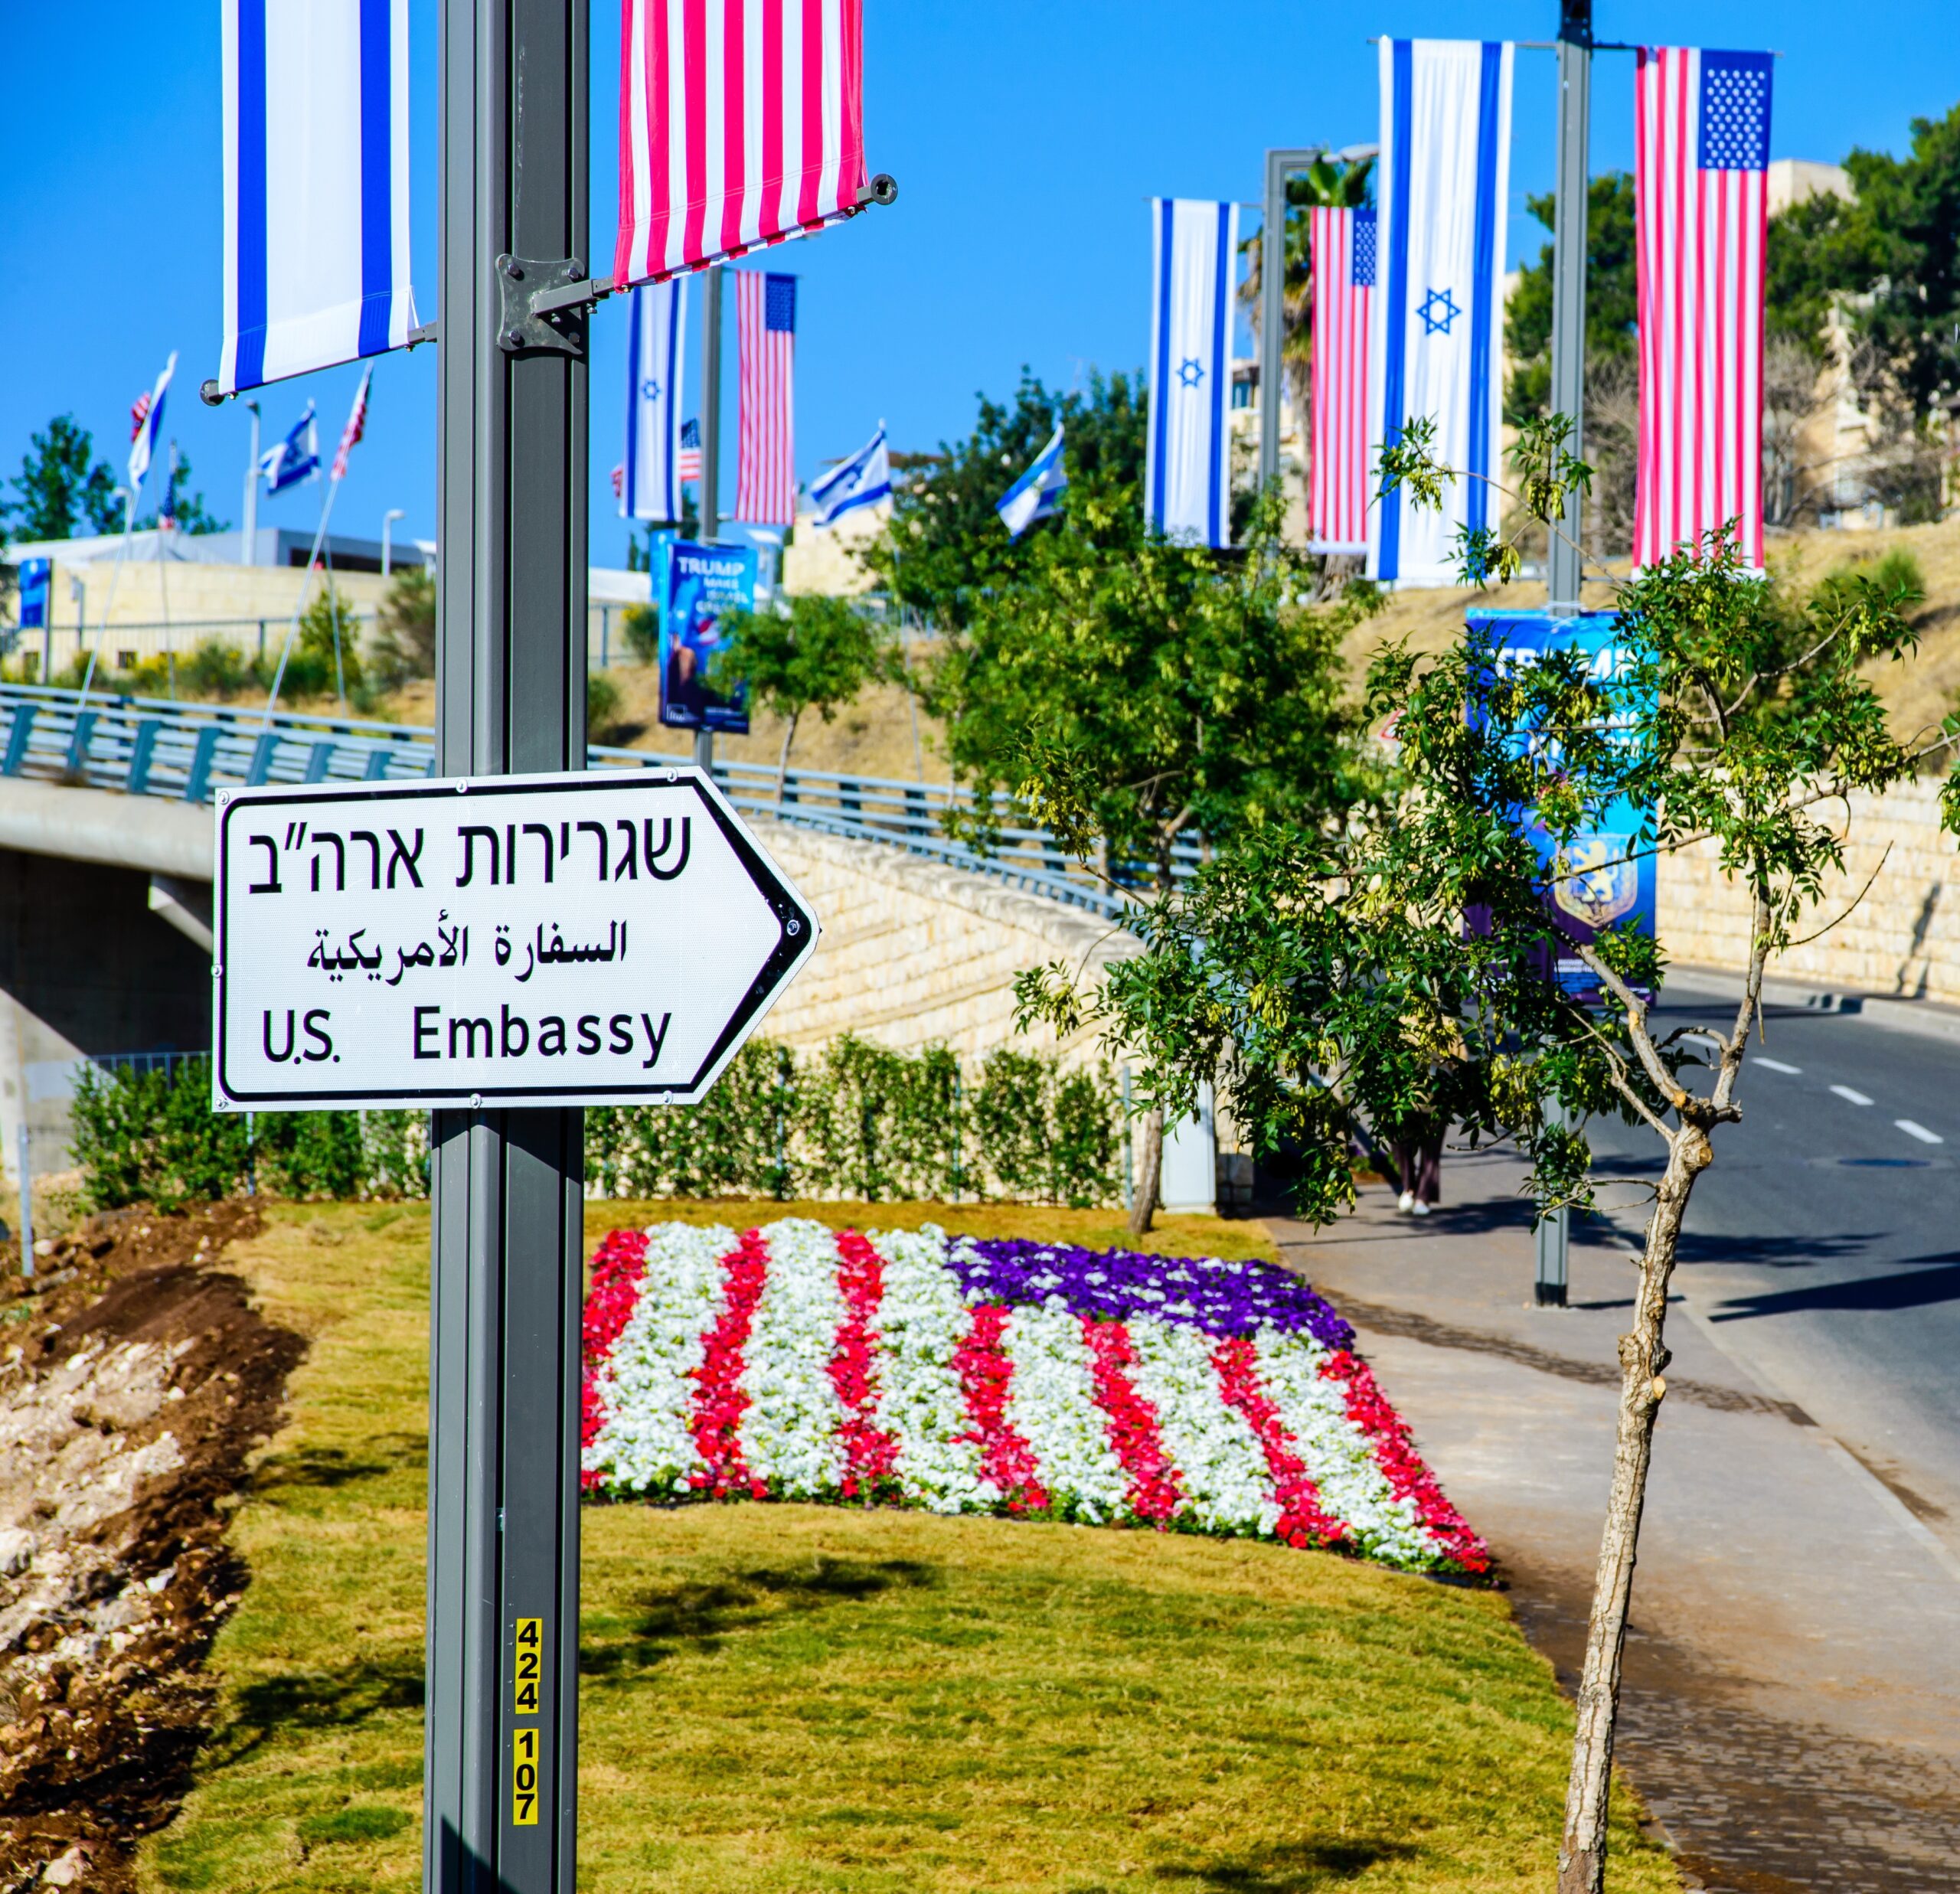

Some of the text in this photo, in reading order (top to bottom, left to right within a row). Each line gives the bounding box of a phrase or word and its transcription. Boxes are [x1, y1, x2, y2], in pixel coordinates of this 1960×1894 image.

[677, 557, 746, 576] TRUMP
[1484, 648, 1638, 680] TRMP
[456, 816, 691, 888] שגרירות
[307, 909, 627, 986] السفارة الأمريكية
[263, 1004, 672, 1069] U.S. Embassy
[515, 1621, 539, 1820] 424 107
